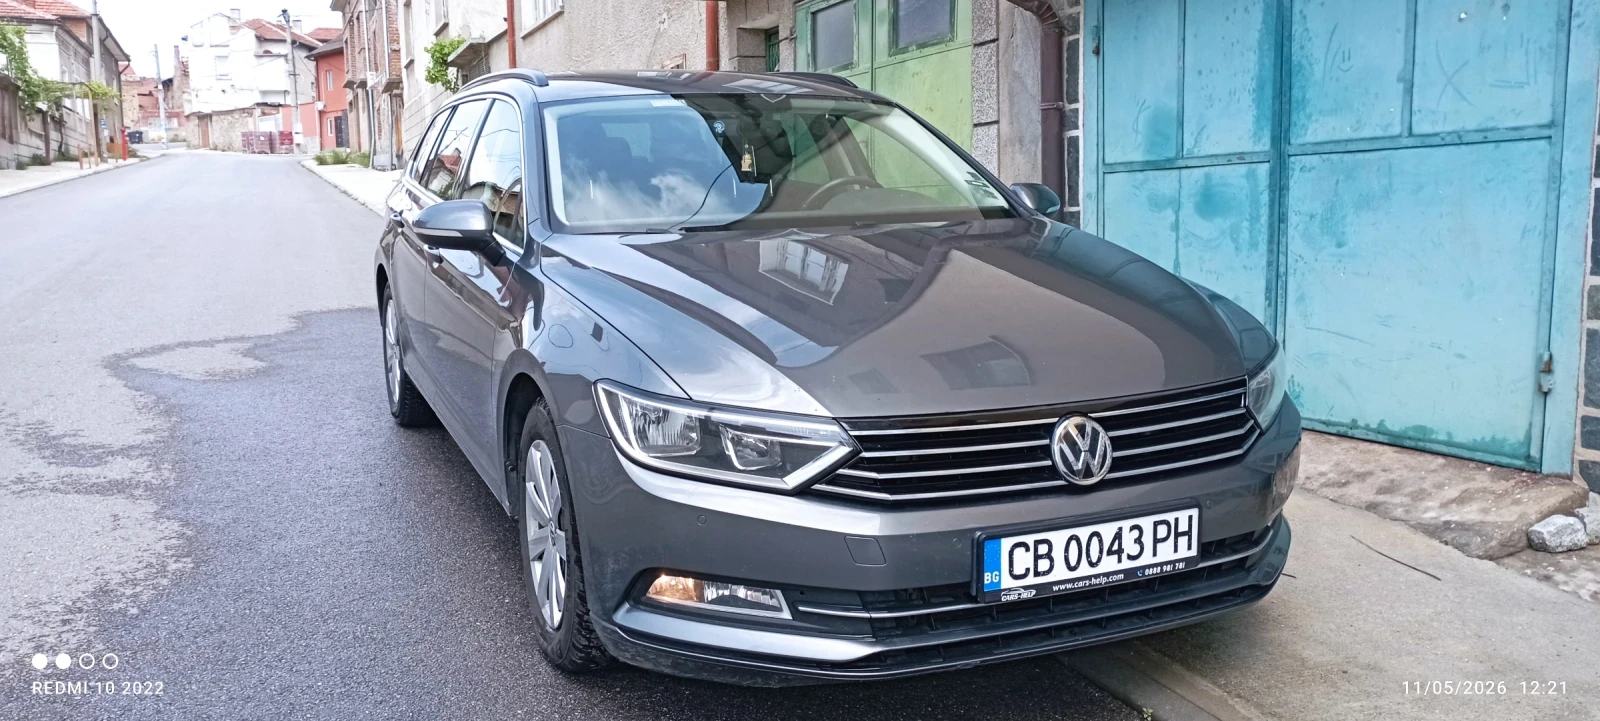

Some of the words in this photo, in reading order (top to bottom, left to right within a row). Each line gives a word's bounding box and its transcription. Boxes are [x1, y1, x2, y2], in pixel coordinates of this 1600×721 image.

[1008, 538, 1055, 580] CB
[1064, 524, 1145, 572] 0043
[1152, 515, 1193, 557] PH
[984, 571, 1000, 584] BG
[1144, 568, 1161, 576] 0888
[1162, 564, 1174, 573] 981
[1052, 574, 1124, 592] www.cars-help.com
